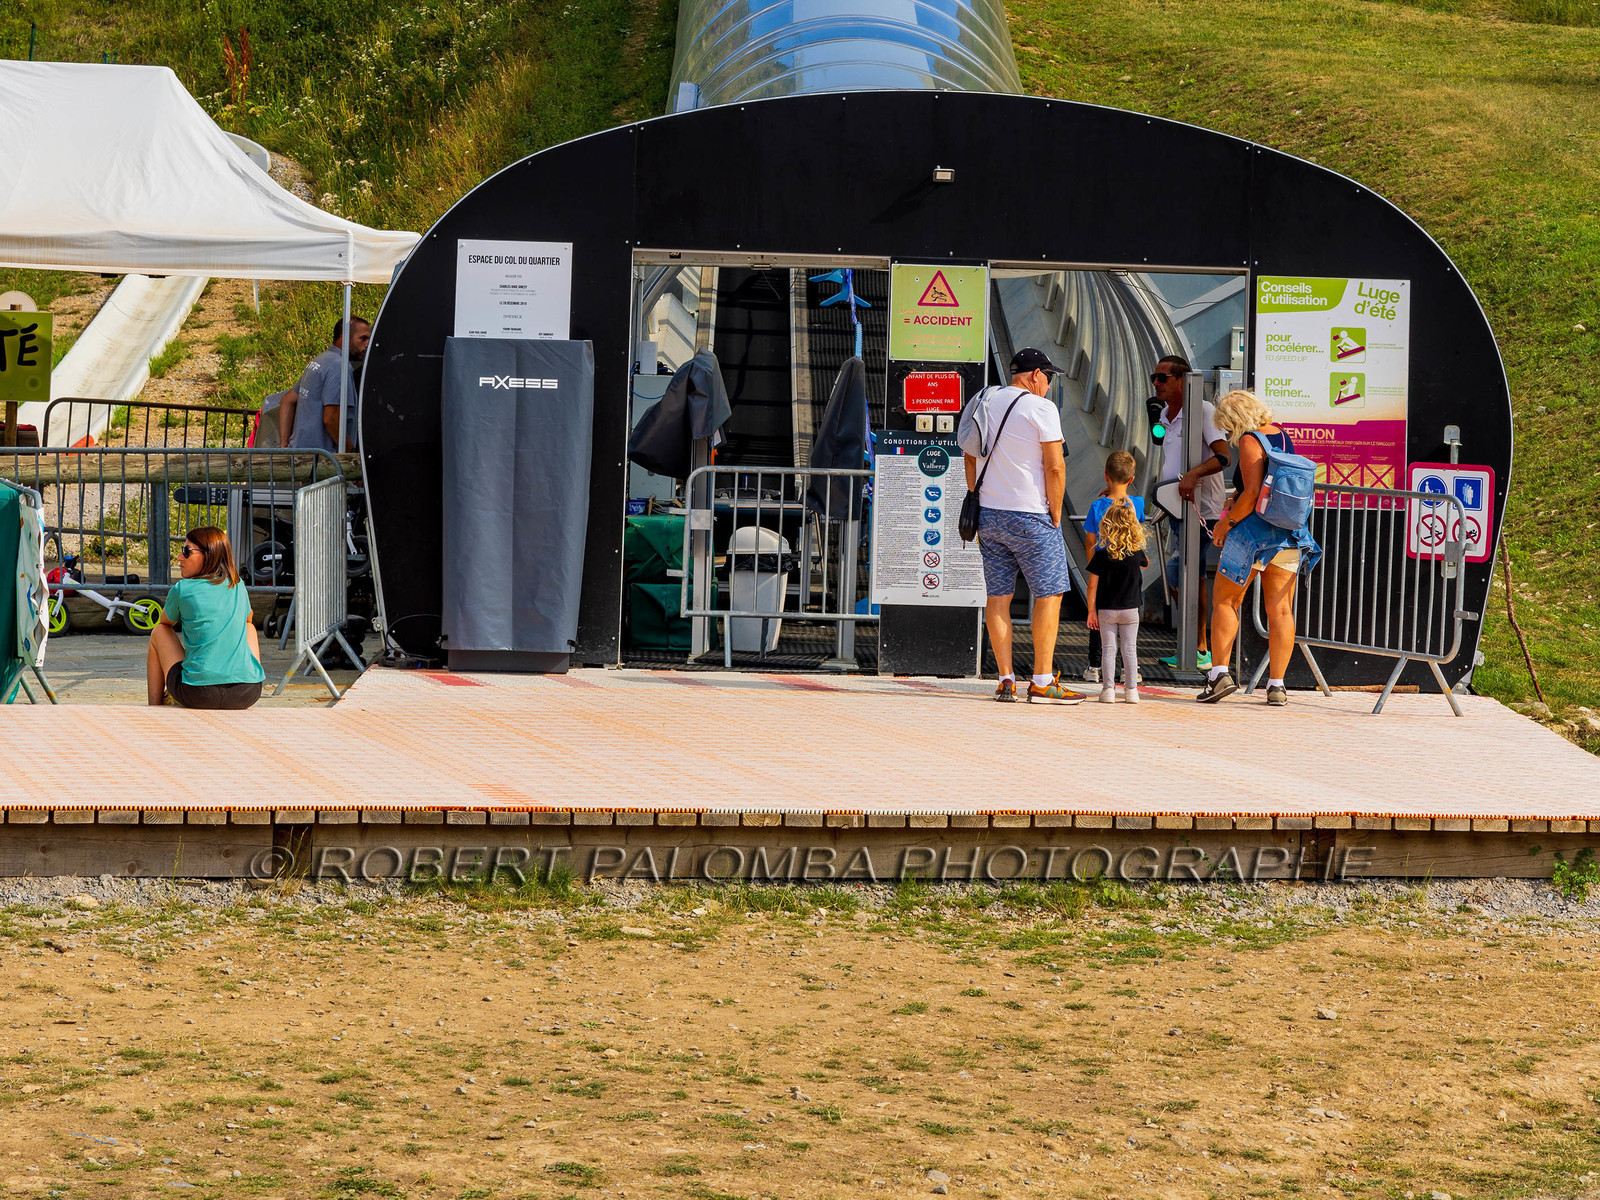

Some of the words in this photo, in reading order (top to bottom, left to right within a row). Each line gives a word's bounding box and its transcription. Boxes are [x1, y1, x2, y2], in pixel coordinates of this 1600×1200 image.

[468, 254, 493, 264] ESPACE
[494, 255, 504, 265] DU
[504, 256, 517, 265] COL
[518, 256, 528, 266] DU
[528, 256, 561, 267] QUARTIER
[1260, 281, 1312, 293] Conseils
[1357, 281, 1401, 304] Luge
[1260, 294, 1328, 306] d'utilisation
[1353, 300, 1397, 321] d'été
[913, 315, 973, 326] ACCIDENT
[1265, 333, 1292, 344] pour
[1265, 342, 1324, 354] accélérer...
[1275, 354, 1297, 362] SPEED
[479, 375, 559, 390] AXESS
[1264, 377, 1293, 389] pour
[1284, 427, 1335, 440] ENTION
[883, 438, 928, 446] CONDITIONS
